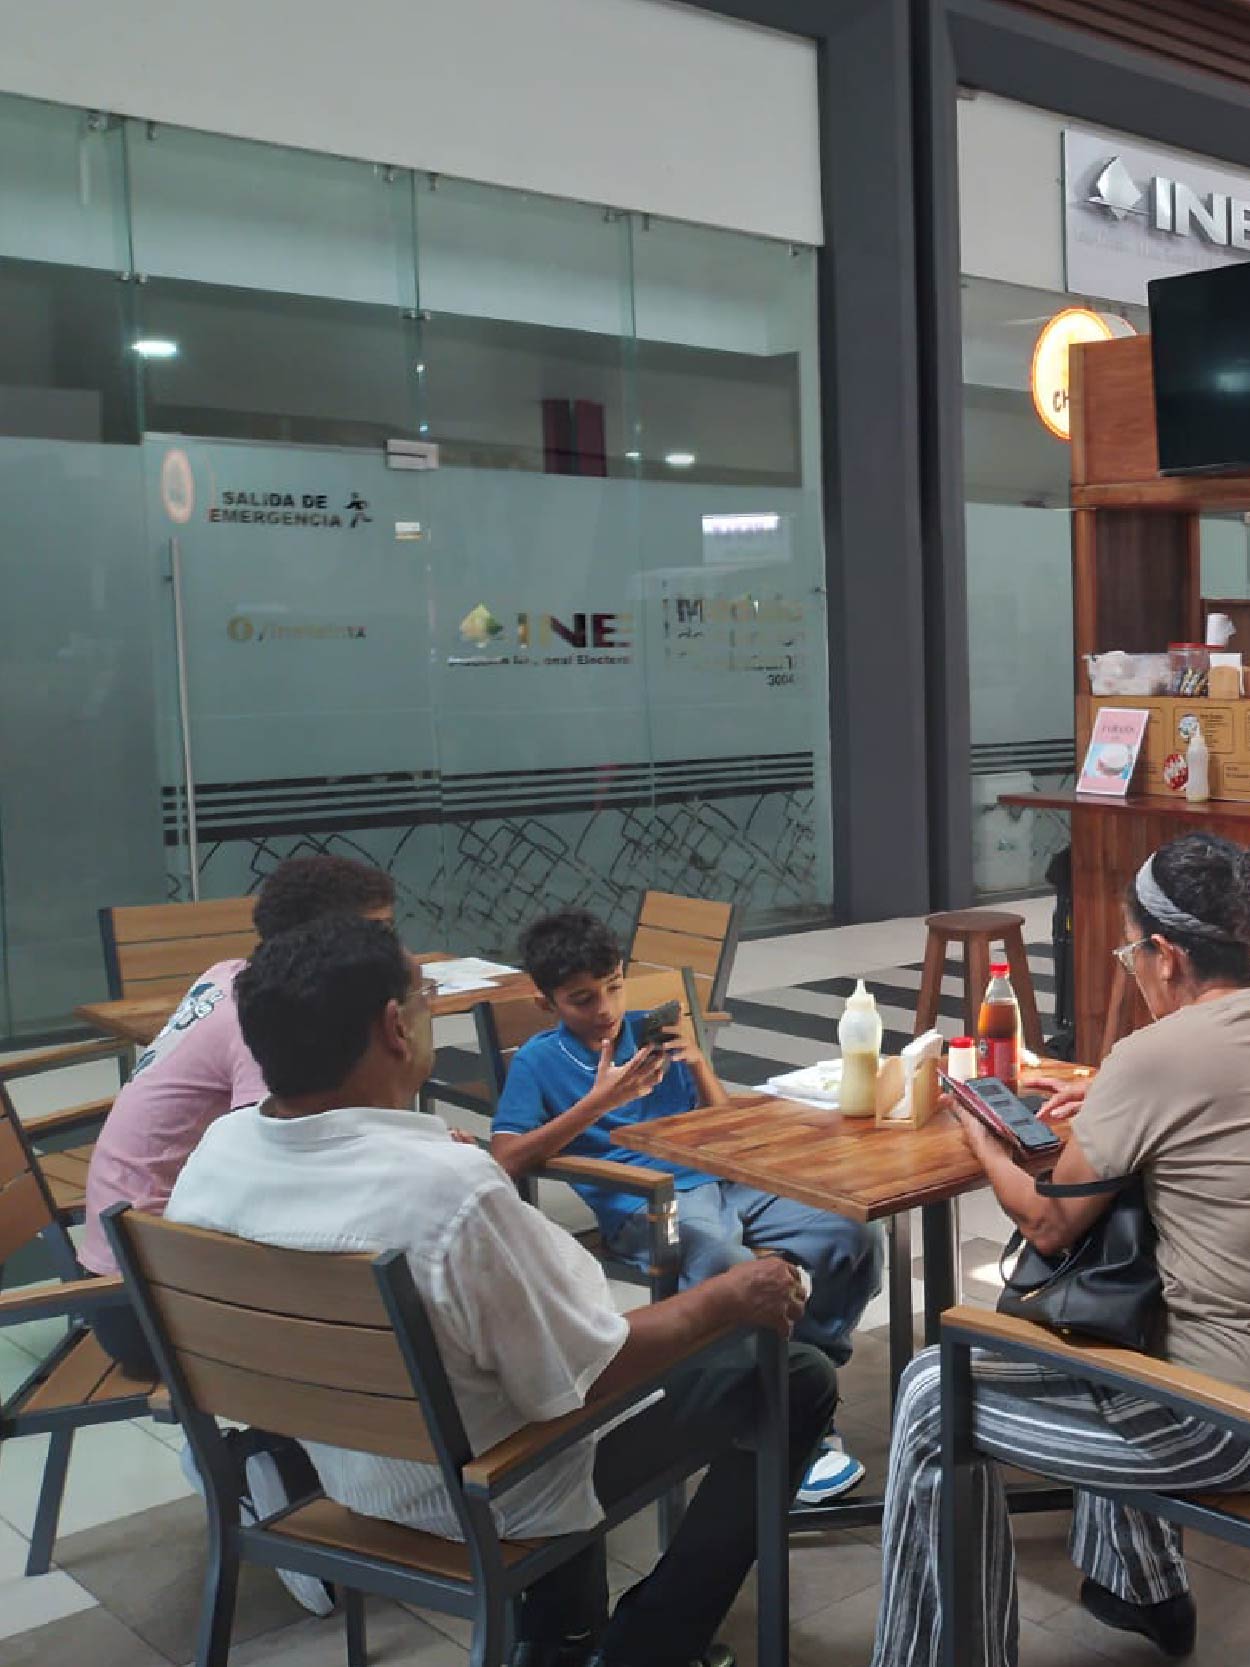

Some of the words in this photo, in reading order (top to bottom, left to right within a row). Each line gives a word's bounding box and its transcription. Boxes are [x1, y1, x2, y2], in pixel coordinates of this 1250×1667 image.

[222, 492, 295, 507] SALIDA
[302, 495, 328, 508] DE
[209, 509, 342, 527] EMERGENCIA
[516, 612, 634, 649] INE
